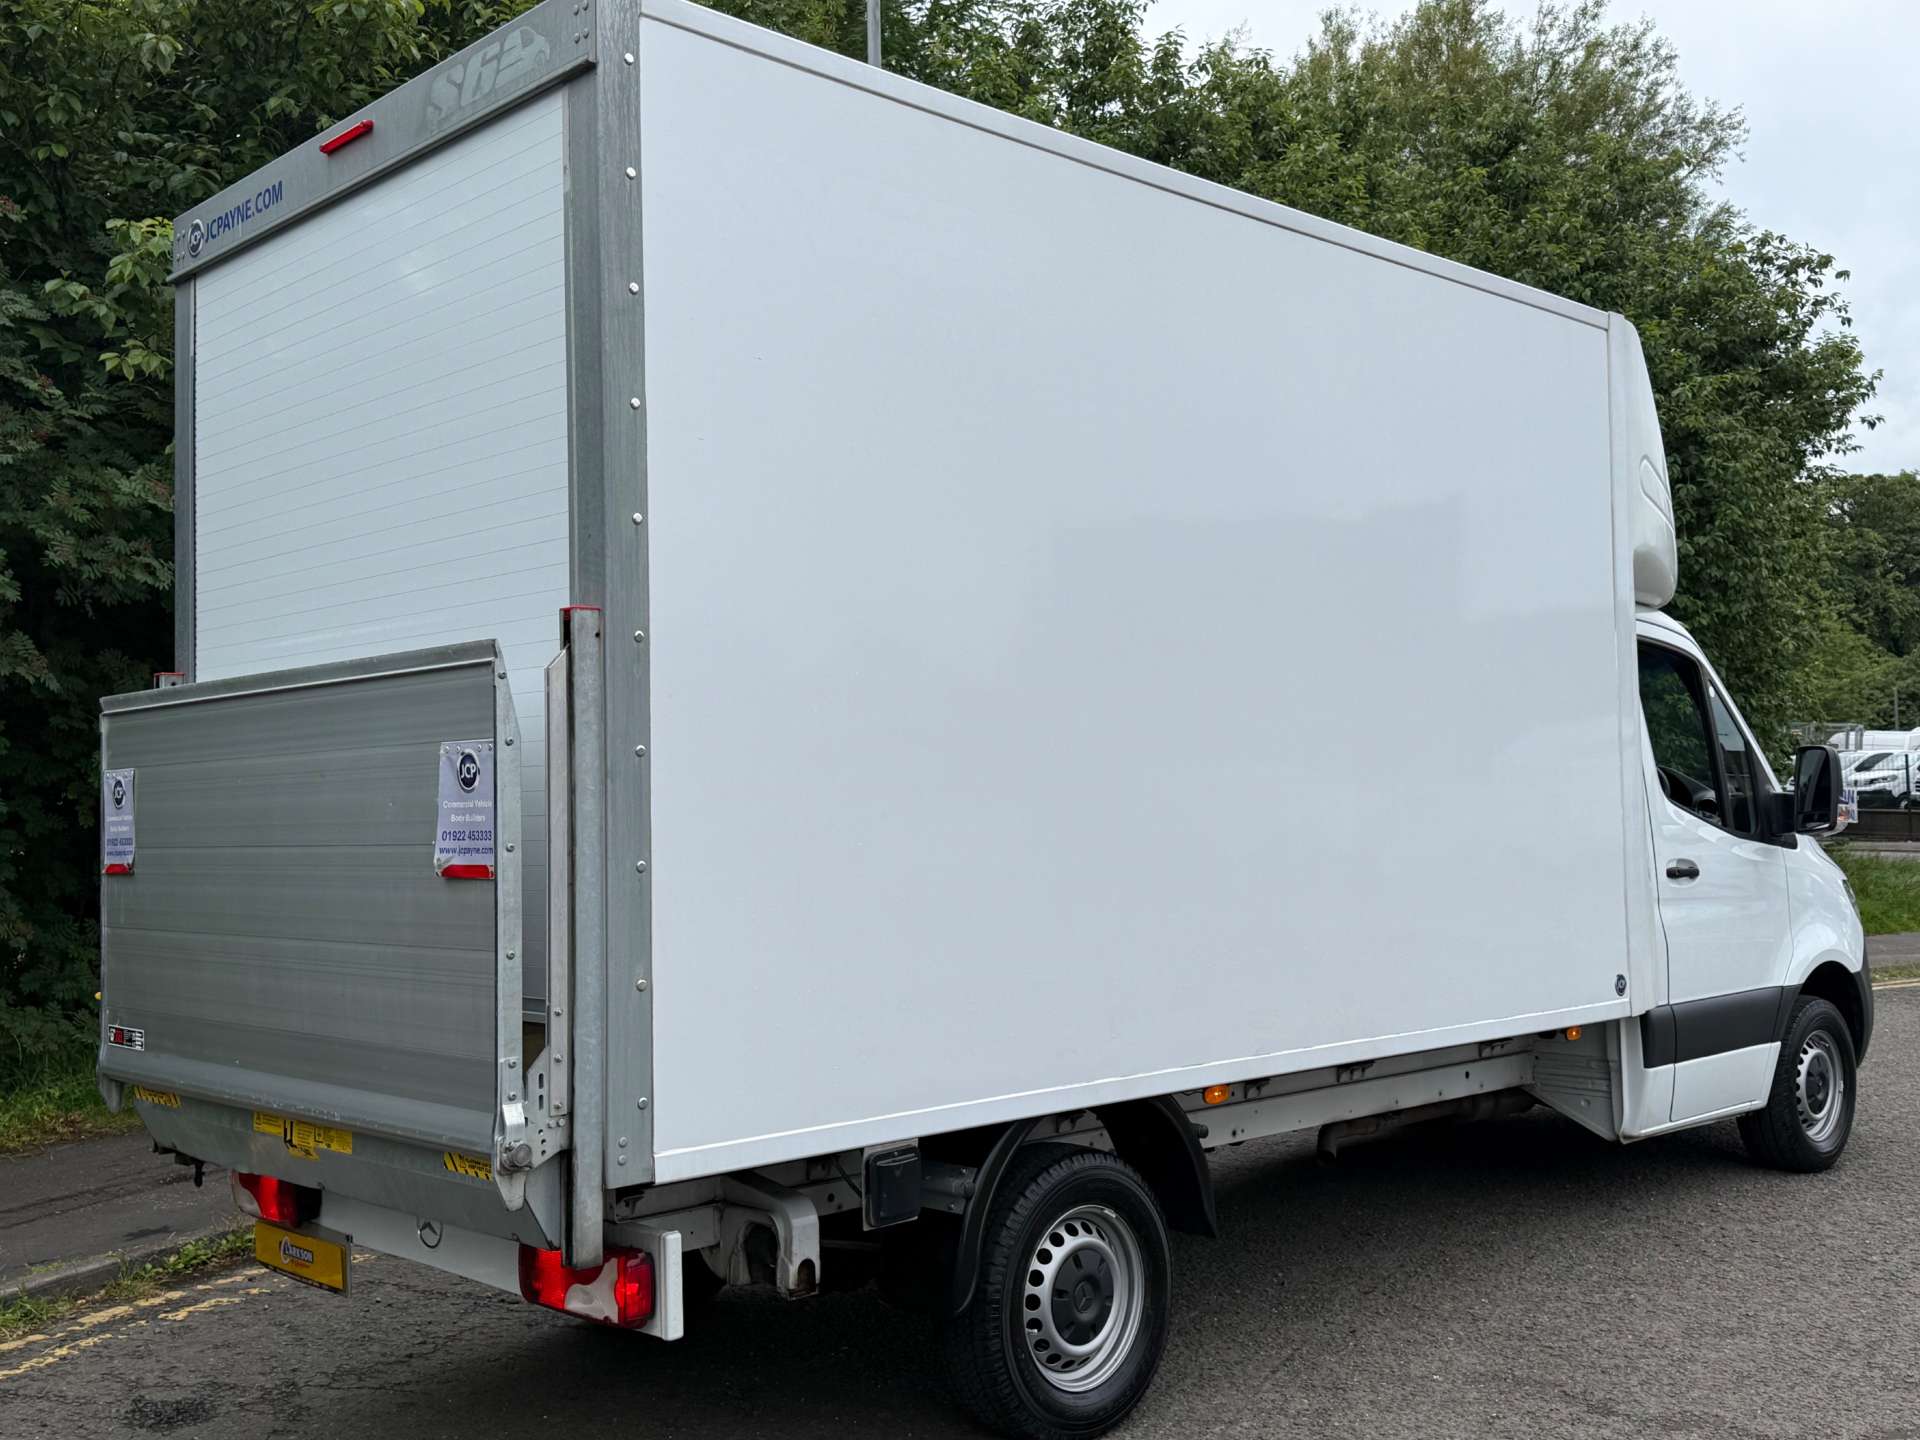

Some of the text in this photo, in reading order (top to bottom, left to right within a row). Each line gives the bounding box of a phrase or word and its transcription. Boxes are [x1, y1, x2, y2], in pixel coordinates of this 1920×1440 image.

[204, 180, 283, 243] JCPAYNE.COM
[461, 763, 477, 778] JCP
[441, 830, 492, 841] 01922 453333
[439, 846, 494, 857] www.jcpayne.com
